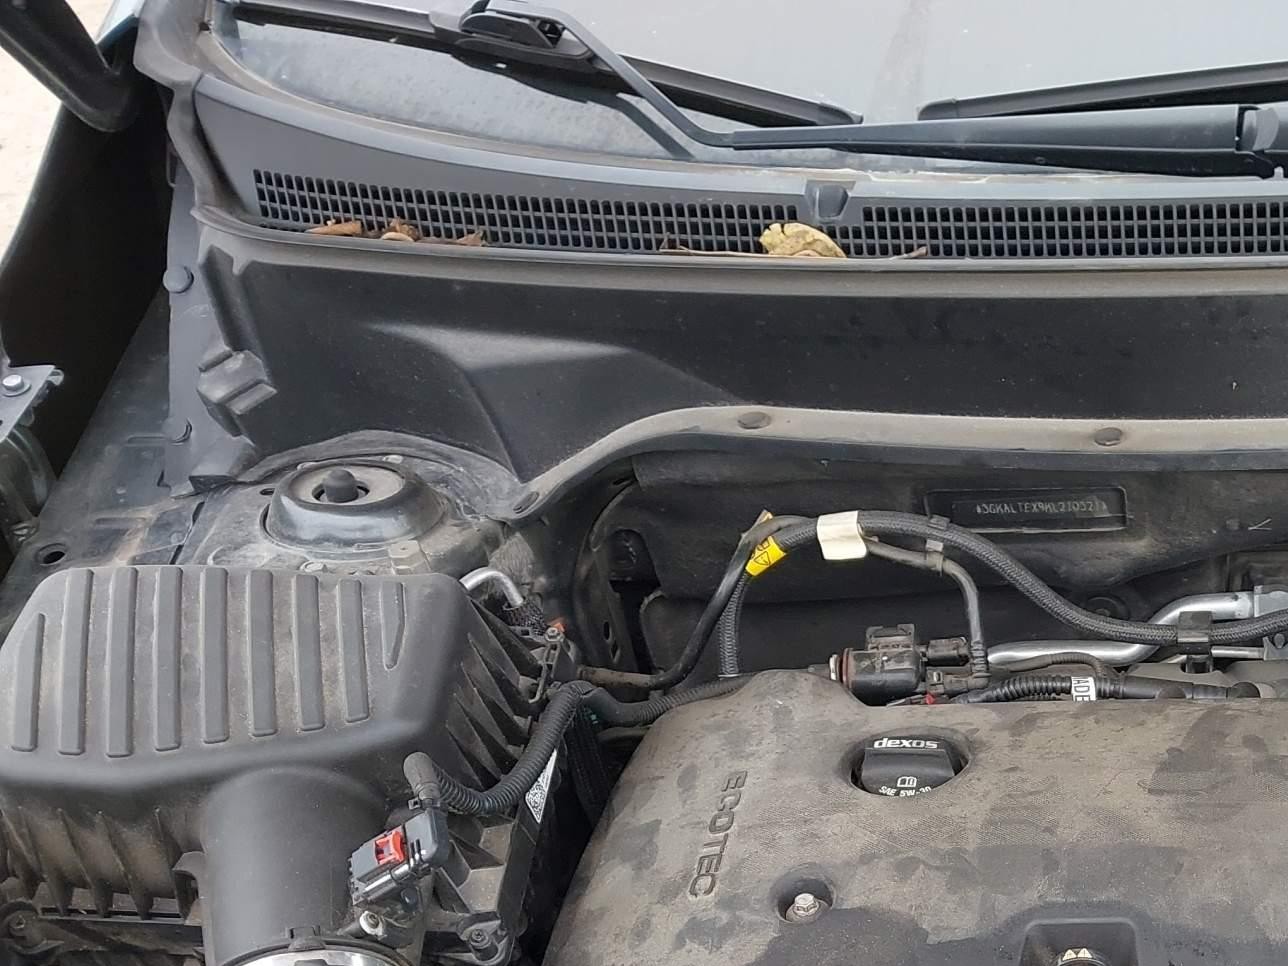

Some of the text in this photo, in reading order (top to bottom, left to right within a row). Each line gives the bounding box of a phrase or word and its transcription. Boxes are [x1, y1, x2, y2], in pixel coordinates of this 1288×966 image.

[873, 738, 939, 748] dexos
[879, 786, 898, 797] SAE
[689, 771, 748, 897] ECOTEC
